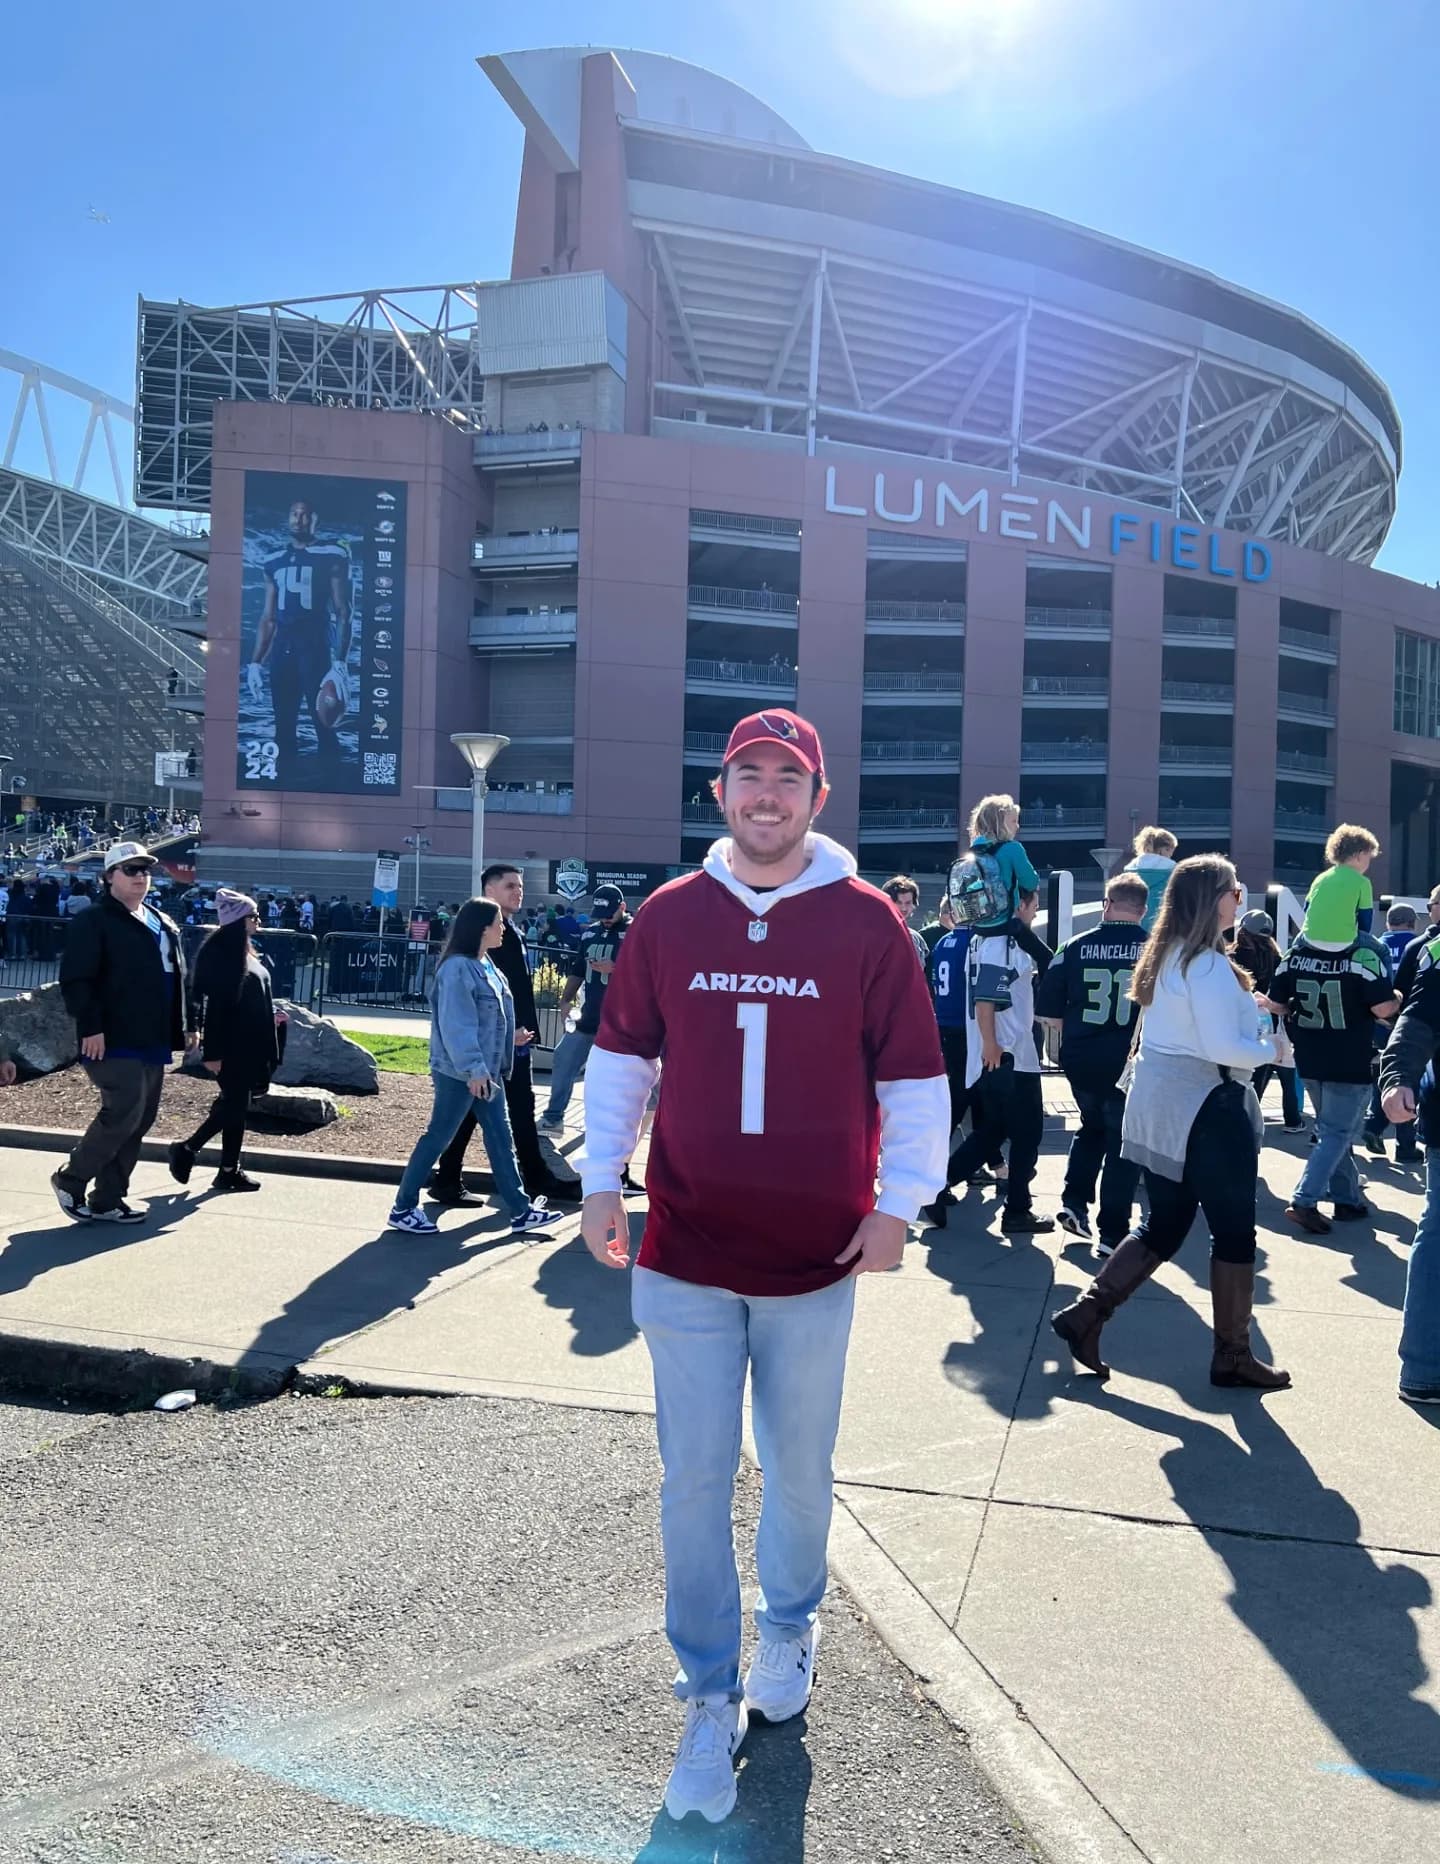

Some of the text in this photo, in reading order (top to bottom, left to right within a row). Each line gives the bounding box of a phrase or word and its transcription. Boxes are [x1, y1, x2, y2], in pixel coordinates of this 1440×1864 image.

[825, 466, 1272, 583] LUMEN FIELD
[274, 566, 313, 611] 14
[245, 761, 278, 780] 24
[246, 740, 279, 759] 20
[348, 952, 398, 967] LUMEN
[688, 973, 820, 998] ARIZONA
[1083, 967, 1136, 1026] 31
[1296, 979, 1346, 1029] 31
[736, 1002, 768, 1135] 1
